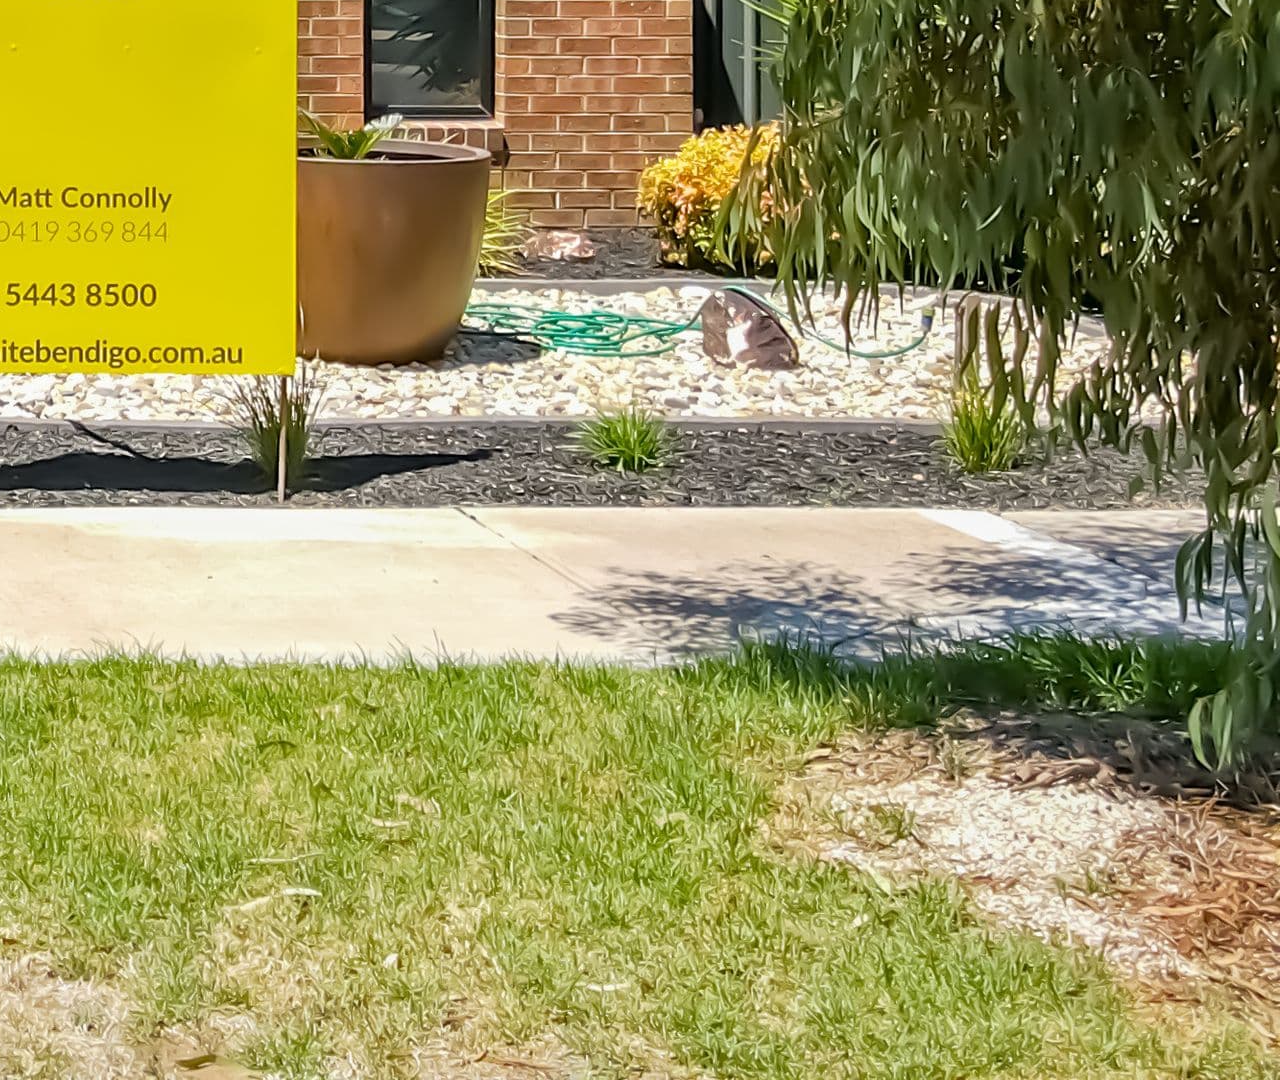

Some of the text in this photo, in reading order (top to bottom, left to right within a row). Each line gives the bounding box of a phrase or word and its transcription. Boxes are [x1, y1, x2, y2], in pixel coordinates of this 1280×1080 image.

[61, 186, 173, 213] Connolly
[66, 220, 114, 243] 369
[121, 221, 168, 243] 844
[5, 283, 157, 307] 5443 8500
